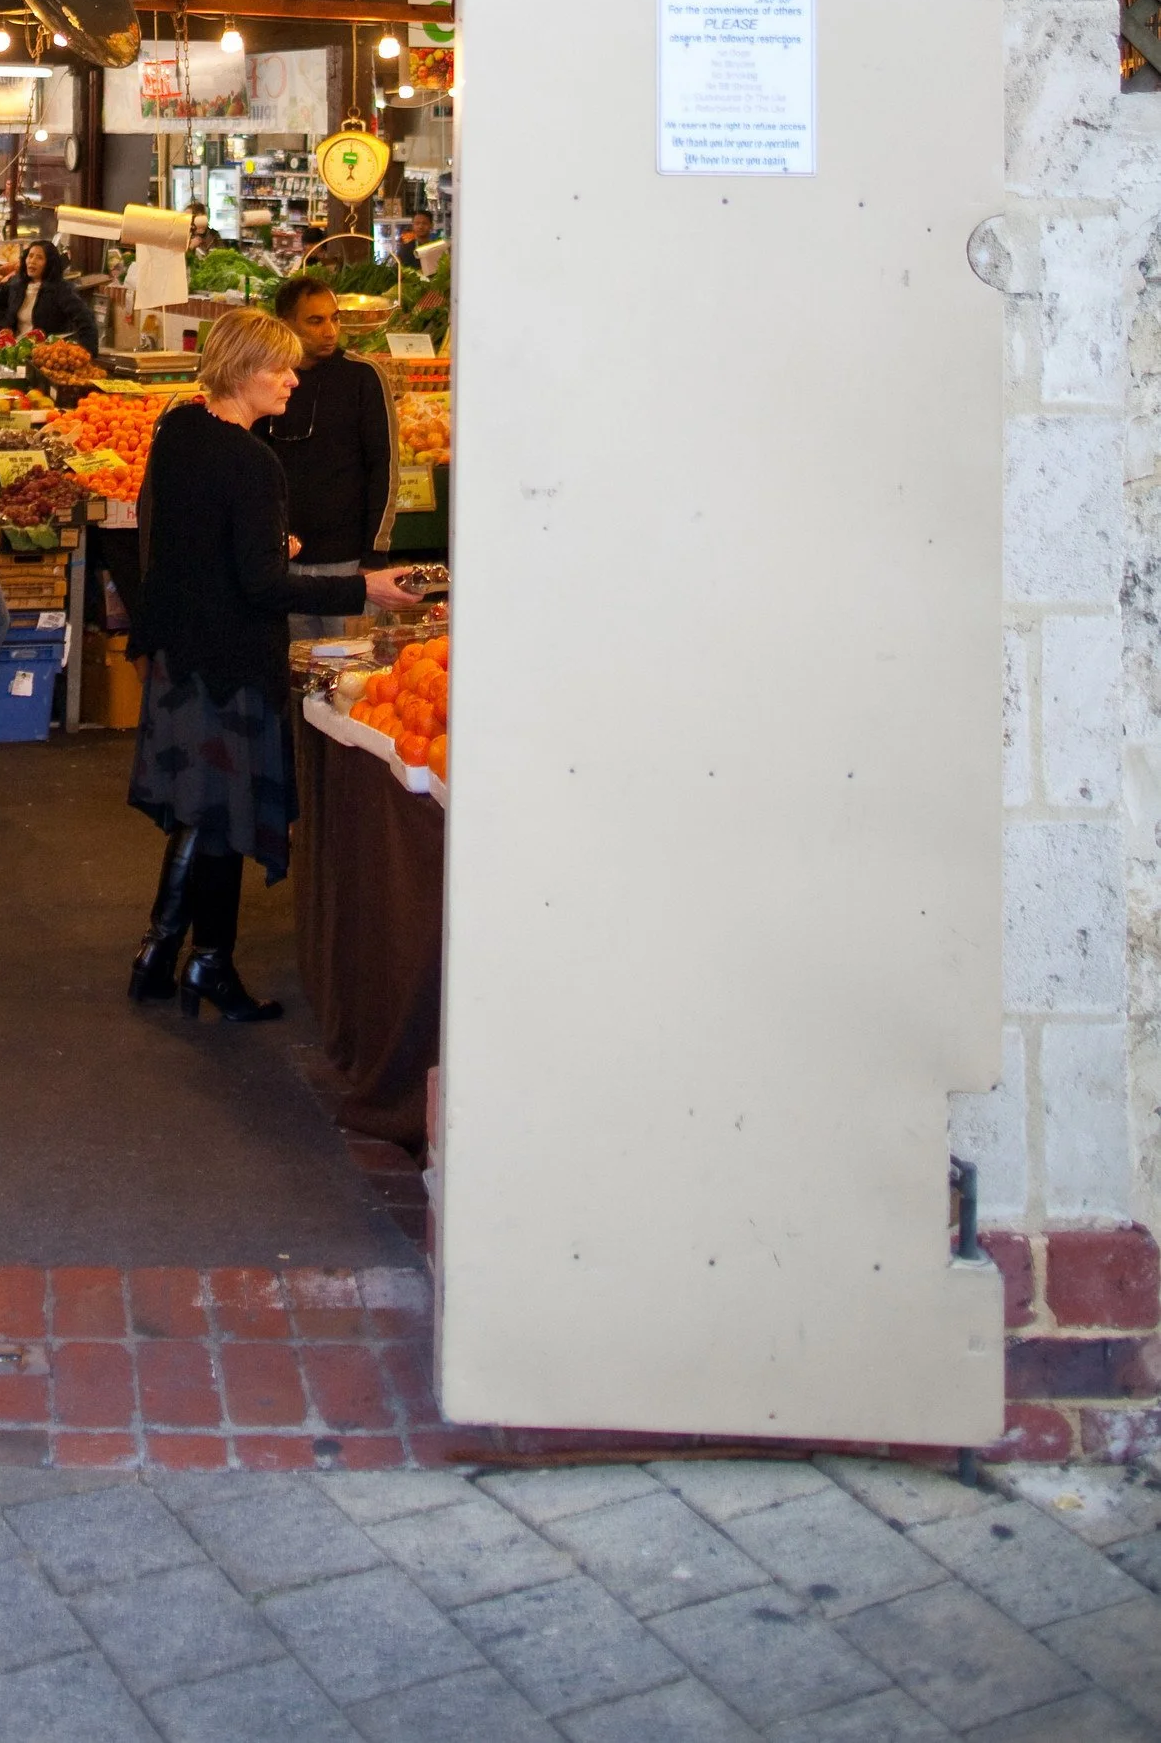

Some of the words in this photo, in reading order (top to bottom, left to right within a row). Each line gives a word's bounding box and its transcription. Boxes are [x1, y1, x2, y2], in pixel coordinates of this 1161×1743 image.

[668, 5, 682, 15] For
[686, 5, 700, 14] the
[703, 6, 759, 15] convenience
[773, 7, 802, 15] others
[704, 19, 759, 30] PLEASE
